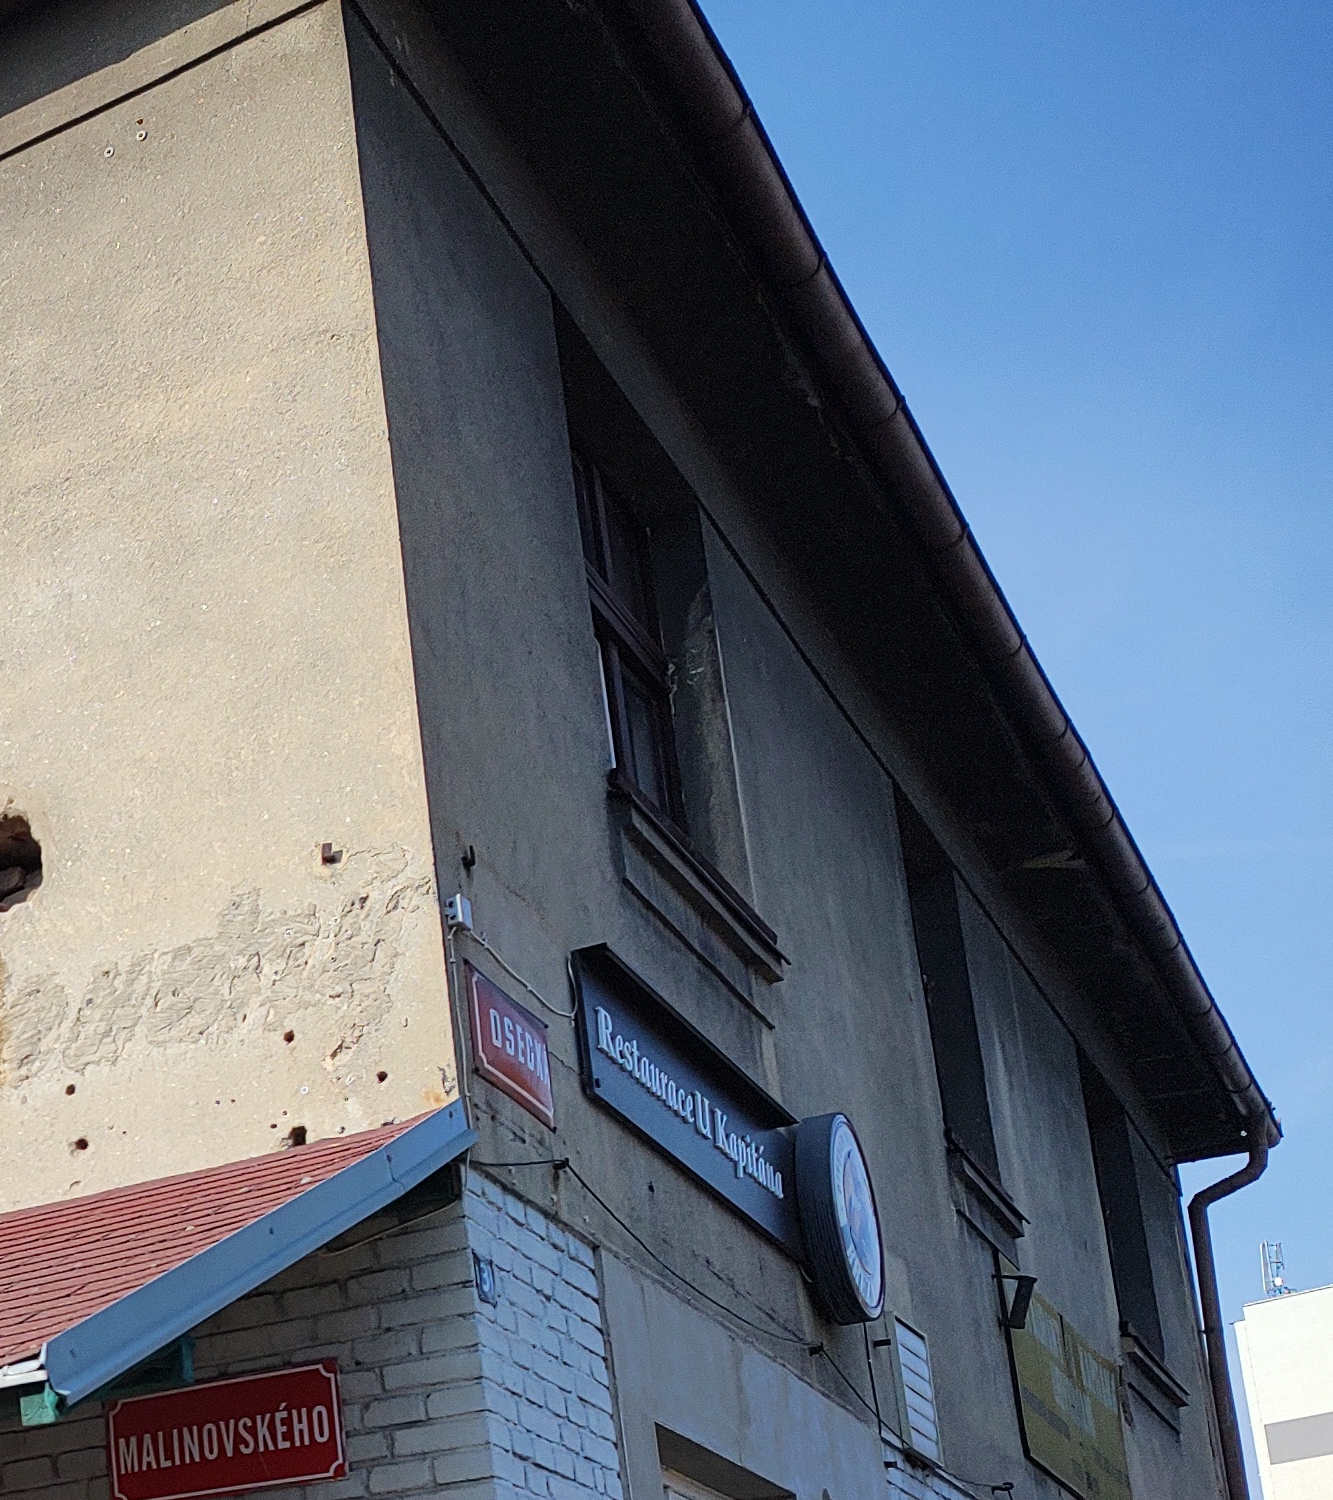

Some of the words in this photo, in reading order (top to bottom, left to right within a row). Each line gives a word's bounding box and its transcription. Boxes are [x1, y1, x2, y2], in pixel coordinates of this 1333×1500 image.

[595, 1006, 694, 1123] Restaurace
[695, 1090, 712, 1139] U
[715, 1108, 784, 1198] Kapitána
[118, 1403, 330, 1474] MALINOVSKÉHO
